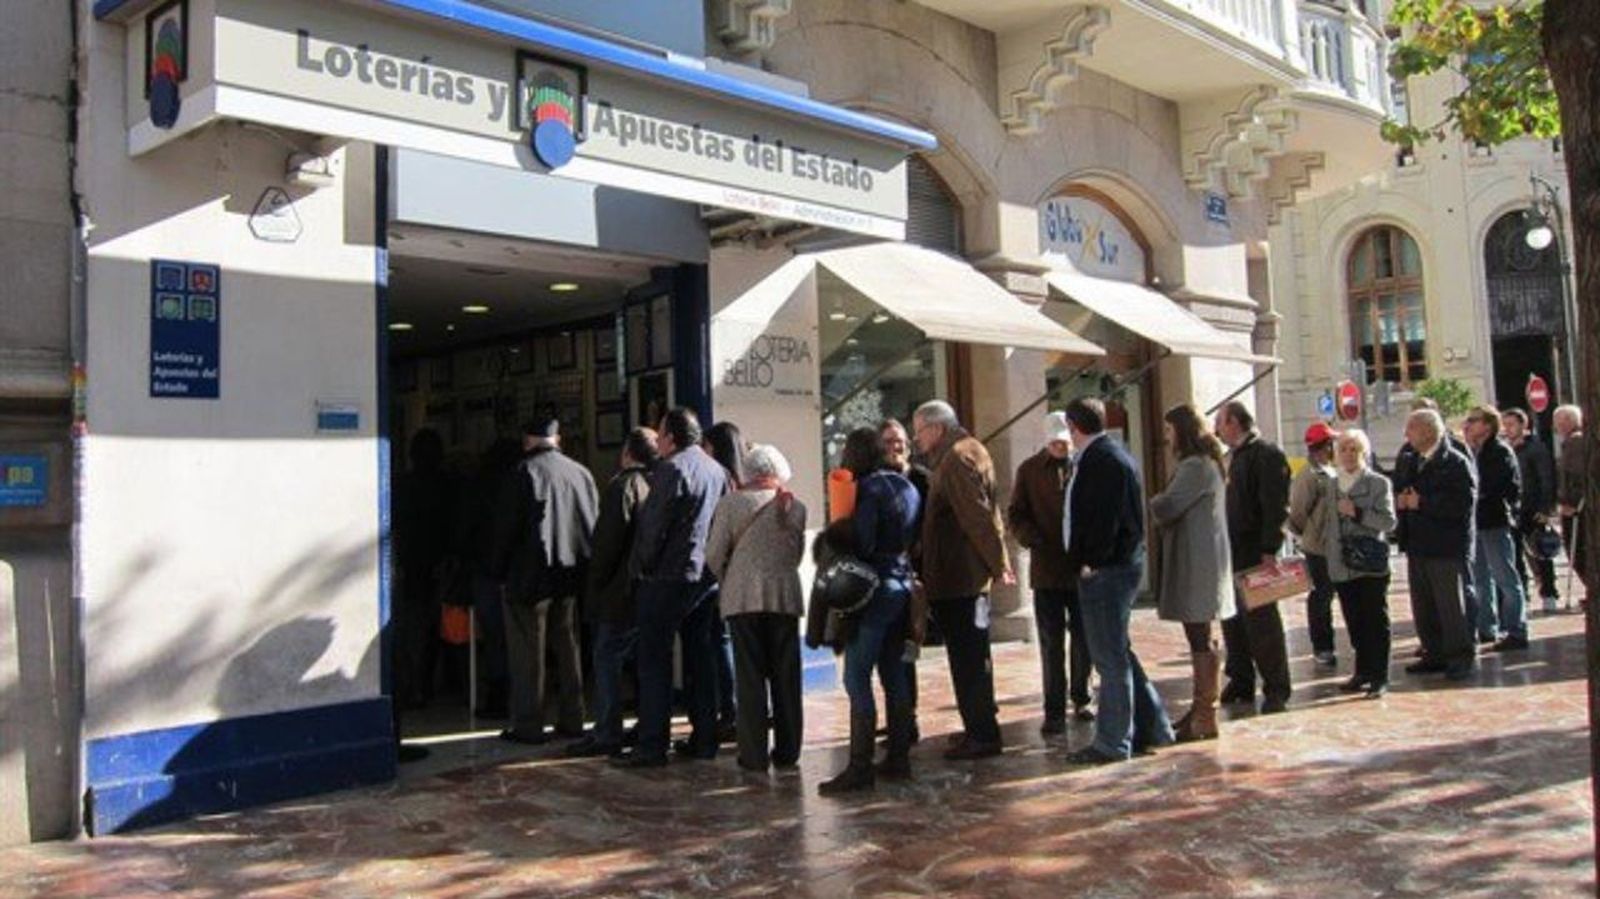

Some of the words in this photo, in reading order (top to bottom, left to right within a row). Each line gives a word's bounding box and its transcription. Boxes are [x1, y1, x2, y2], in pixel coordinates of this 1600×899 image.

[297, 28, 475, 106] Loterías
[487, 83, 507, 121] y
[592, 99, 736, 162] Apuestas
[743, 133, 784, 173] del
[791, 146, 873, 193] Estado
